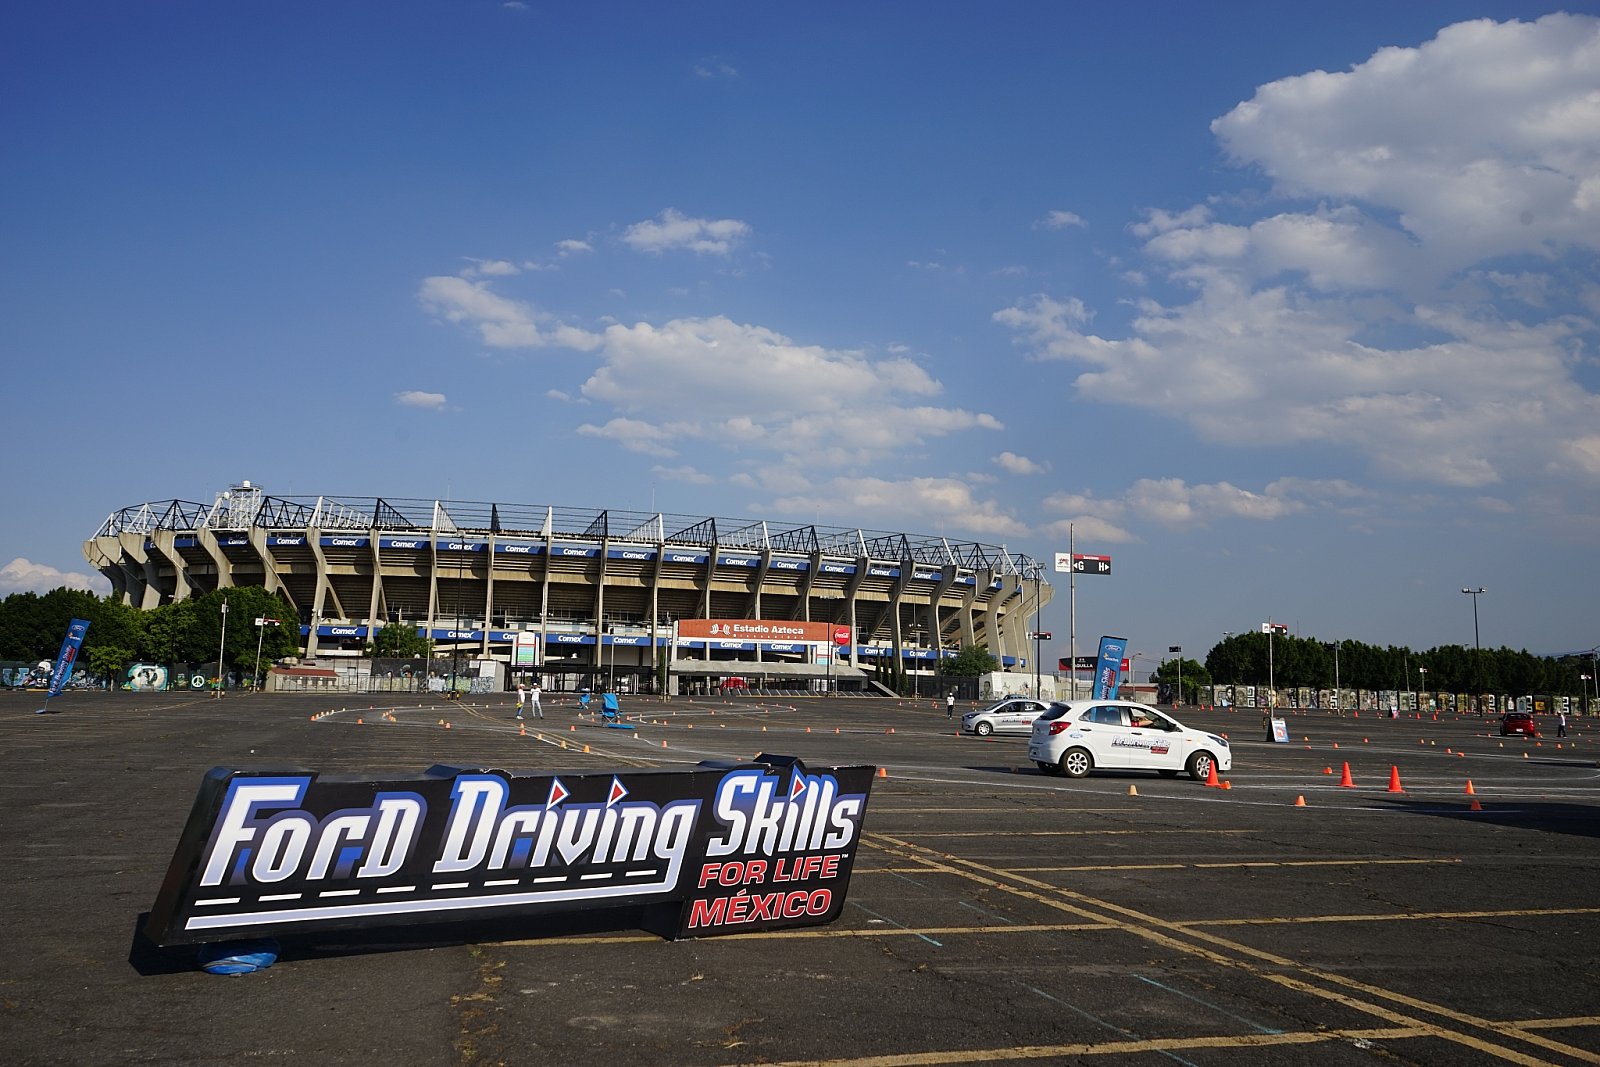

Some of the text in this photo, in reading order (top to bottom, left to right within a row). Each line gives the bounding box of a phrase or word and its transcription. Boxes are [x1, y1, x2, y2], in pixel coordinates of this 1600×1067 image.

[276, 537, 302, 545] Comex
[332, 538, 358, 546] Comex
[391, 540, 418, 548] Comex
[448, 543, 475, 551] Comex
[505, 545, 531, 553] Comex
[563, 548, 589, 556] Comex
[622, 551, 648, 560] Comex
[673, 554, 697, 563] Comex
[726, 558, 748, 566] Comex
[777, 562, 800, 570] Comex
[825, 565, 846, 573] Comex
[1078, 561, 1085, 571] G
[1098, 562, 1105, 571] H
[870, 568, 891, 576] Comex
[914, 572, 933, 580] Comex
[332, 627, 358, 635] Comex
[733, 623, 804, 635] Estadio Azteca
[448, 631, 475, 639] Comex
[558, 635, 583, 643] Comex
[613, 636, 639, 645] Comex
[720, 641, 744, 649] Comex
[771, 643, 795, 651] Comex
[431, 777, 697, 892] Driving
[706, 774, 861, 857] Skills
[697, 860, 748, 888] FOR
[773, 855, 840, 883] LIFE
[688, 888, 832, 928] MÉXICO
